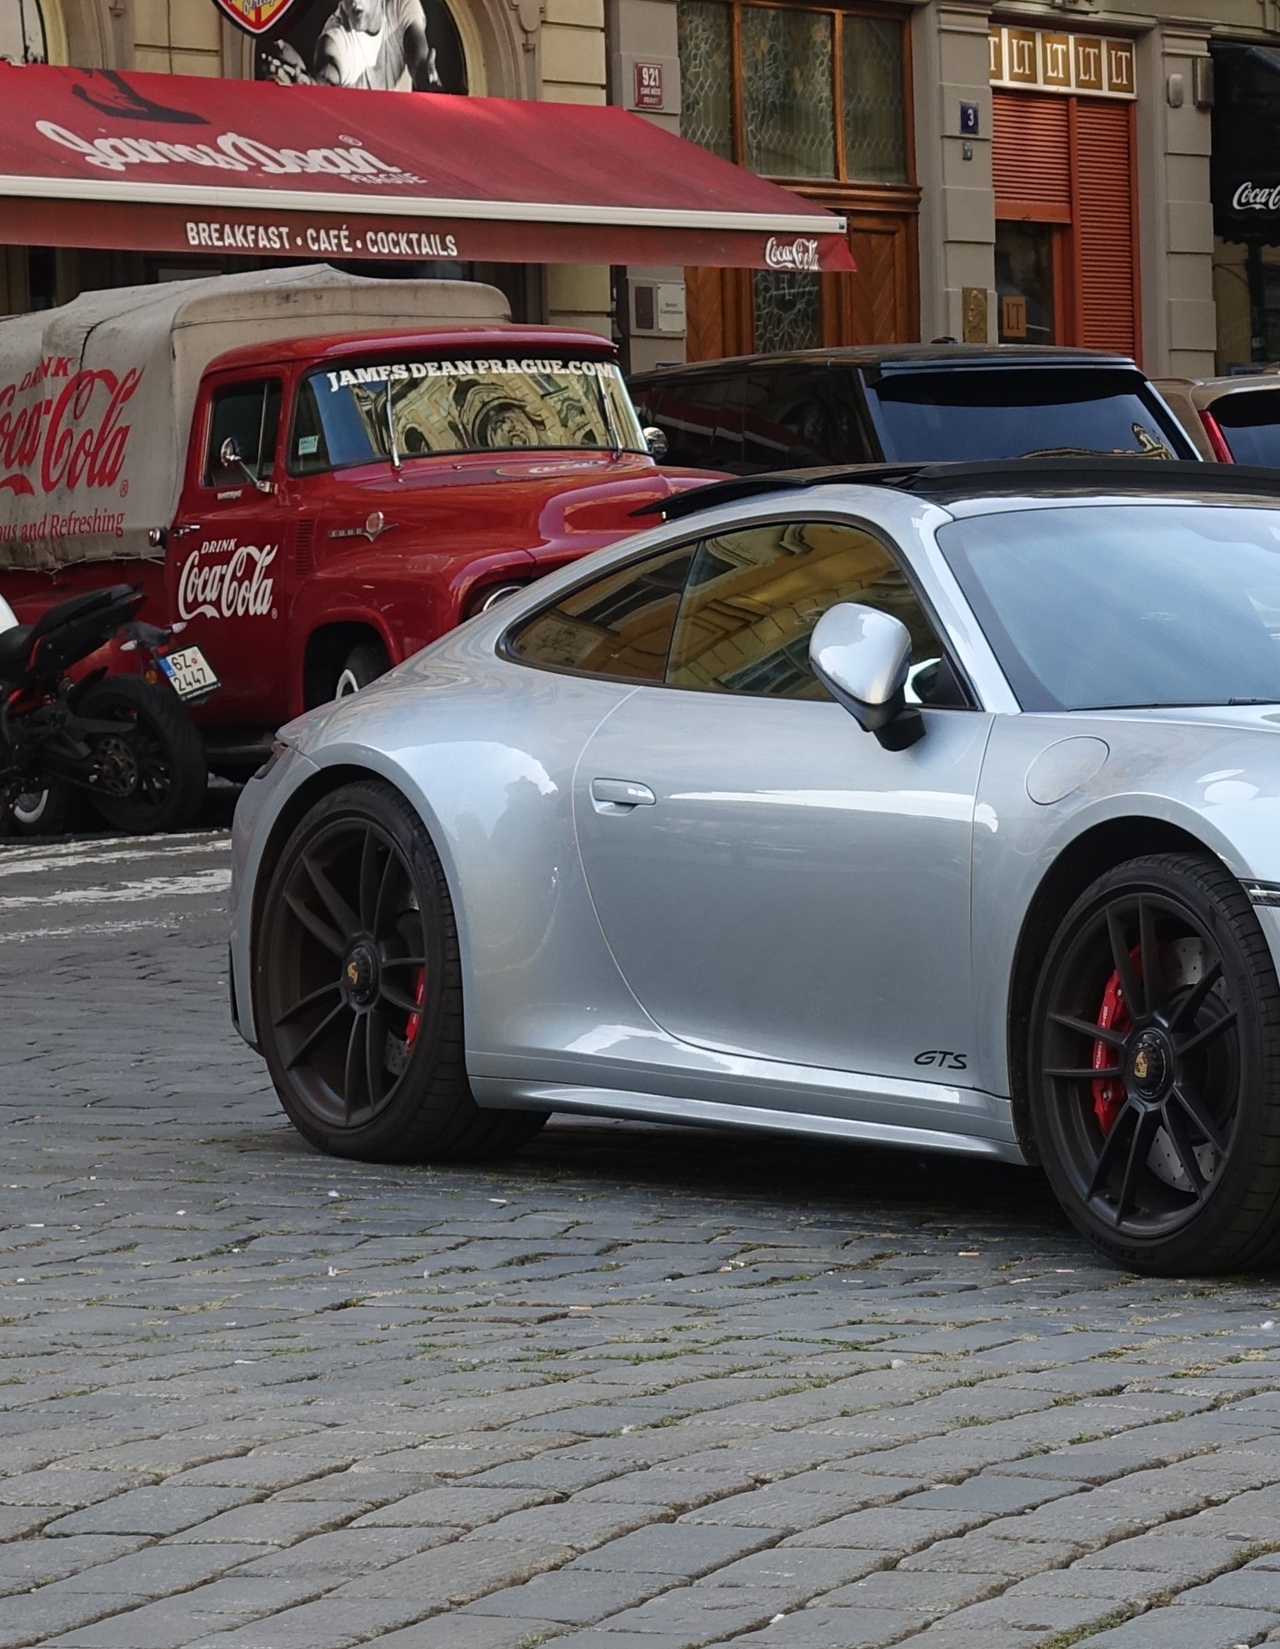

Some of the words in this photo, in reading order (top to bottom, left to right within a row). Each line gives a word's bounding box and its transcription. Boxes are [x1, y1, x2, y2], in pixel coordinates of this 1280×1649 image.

[1011, 38, 1034, 75] LT
[1045, 42, 1067, 78] LT
[1077, 46, 1099, 81] LT
[1110, 50, 1131, 85] LT
[642, 67, 659, 86] 921
[967, 109, 975, 127] 3
[186, 222, 290, 250] BREAKFAST
[306, 223, 353, 253] CAFÉ
[366, 231, 458, 256] COCKTAILS
[1005, 303, 1023, 330] LT
[21, 513, 47, 543] and
[50, 508, 126, 538] Refreshing
[200, 538, 237, 554] DRINK
[171, 653, 192, 671] 6Z
[173, 668, 208, 692] 2447
[913, 1050, 968, 1070] GTS
